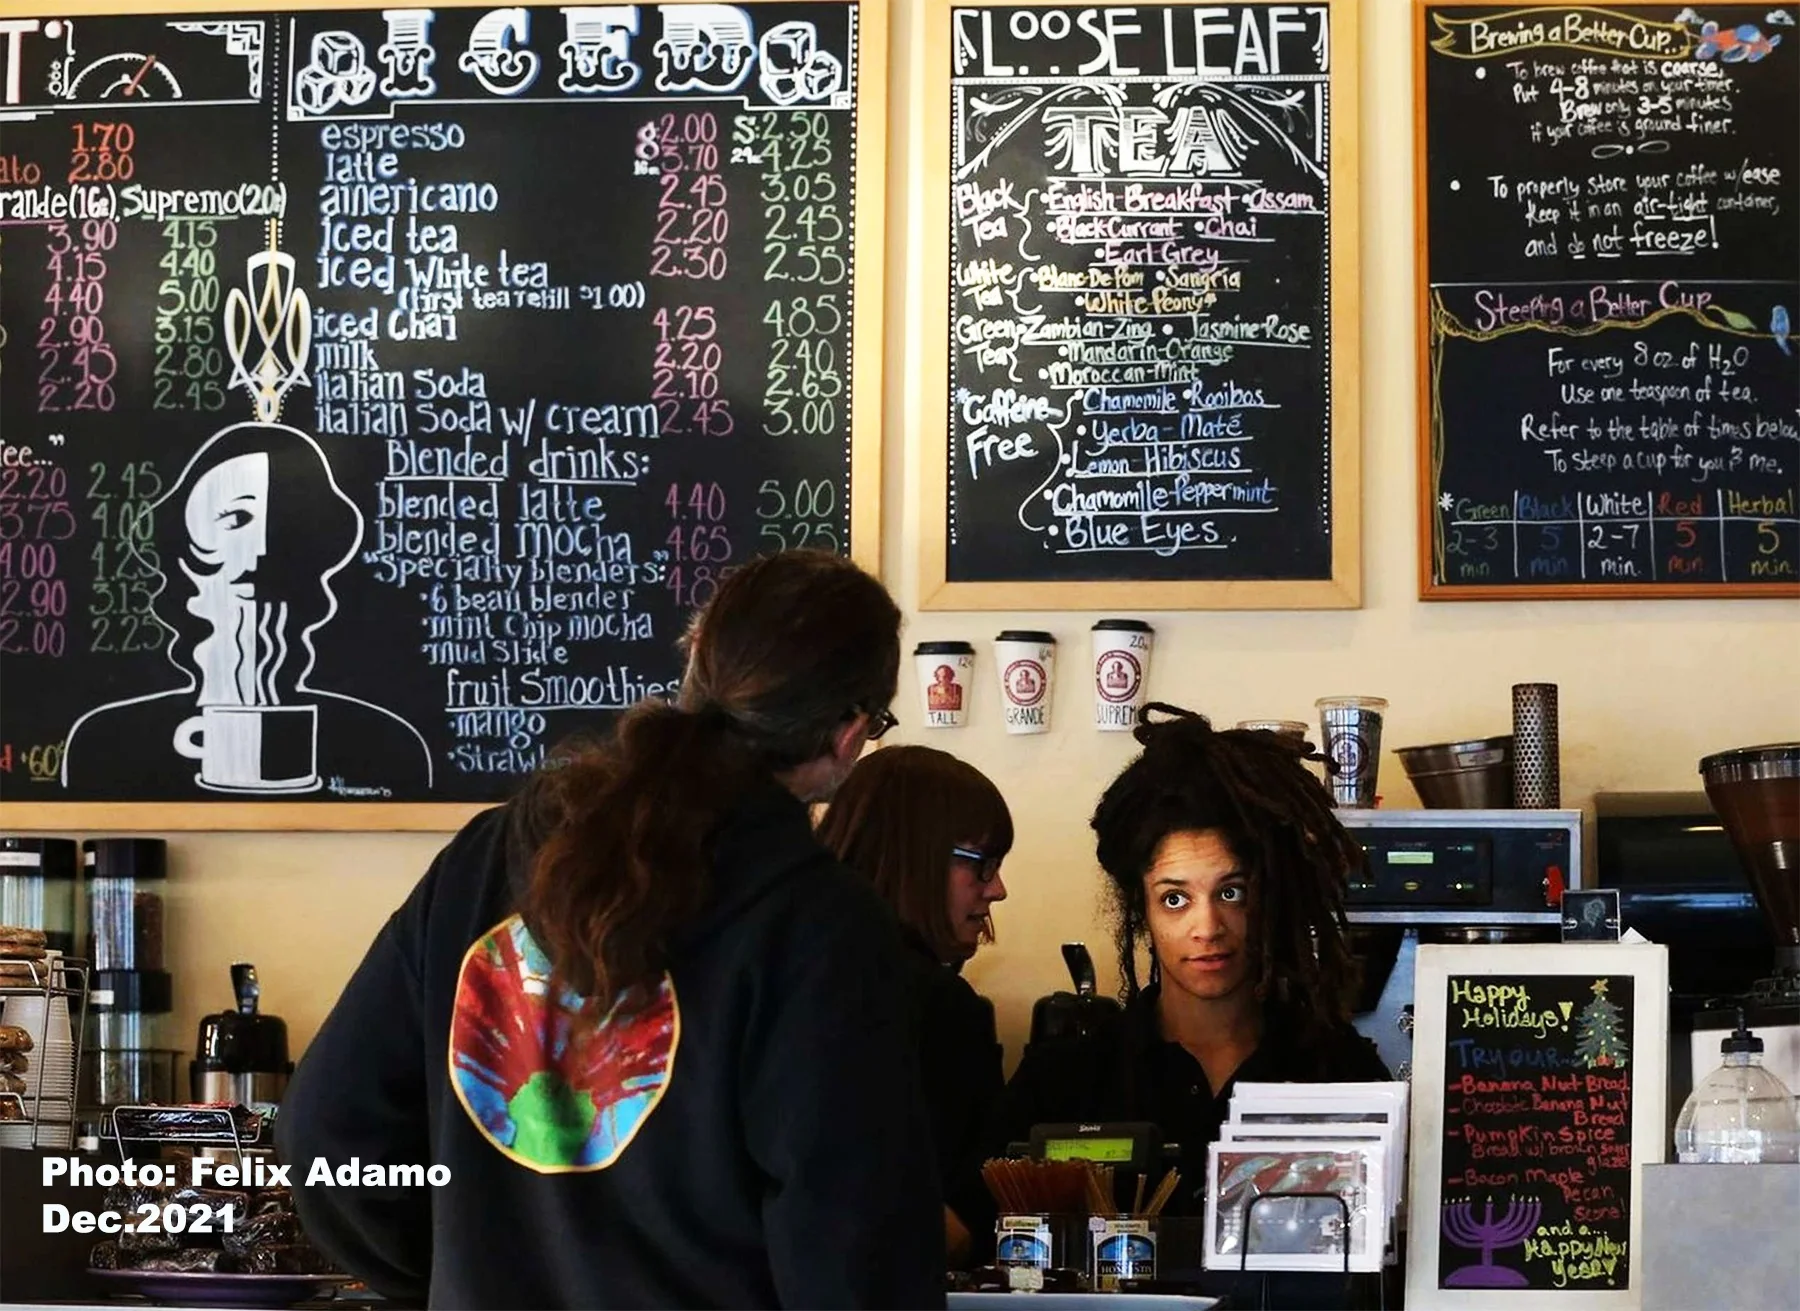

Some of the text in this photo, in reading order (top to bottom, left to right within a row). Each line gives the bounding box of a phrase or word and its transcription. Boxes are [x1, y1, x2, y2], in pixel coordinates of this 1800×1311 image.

[1163, 7, 1306, 76] LEAF
[1471, 13, 1627, 53] Brewing a Better
[378, 5, 756, 97] ICED
[1506, 58, 1723, 80] To brew coffee is coarse,
[1512, 75, 1694, 104] Put 4-8 minutes your
[1560, 94, 1732, 124] Brew only 3-5 minutes
[71, 123, 134, 153] 1.70
[321, 122, 465, 153] espresso
[1042, 105, 1250, 177] TEA
[1530, 112, 1736, 146] if your is ground finer.
[68, 152, 134, 184] 2.80
[325, 152, 398, 183] latte
[761, 138, 832, 172] 4.25
[320, 178, 498, 216] americano
[659, 174, 727, 209] 2.45
[957, 178, 1018, 218] Black
[1487, 162, 1718, 202] To properly your coffee
[47, 219, 117, 254] 3.90
[321, 216, 458, 256] iced tea
[654, 208, 729, 244] 2.20
[765, 204, 843, 242] 2.45
[962, 211, 1008, 247] Tea
[1205, 215, 1257, 237] Chai
[1525, 214, 1719, 257] and do not freeze!
[317, 249, 549, 294] iced tea
[650, 245, 727, 280] 2.30
[763, 242, 845, 285] 2.55
[957, 258, 1016, 286] White
[1166, 263, 1241, 295] Sangria
[45, 282, 103, 317] 4.40
[157, 276, 219, 315] 5.00
[472, 288, 509, 309] tea
[962, 284, 1003, 311] Tea
[1475, 280, 1712, 331] Steeping a Better Cup
[37, 316, 103, 348] 2.90
[313, 307, 457, 341] iced Chai
[653, 306, 716, 342] 4.25
[763, 295, 841, 338] 4.85
[957, 315, 1015, 345] Green
[38, 343, 116, 383] 2.45
[154, 345, 222, 378] 2.80
[315, 338, 379, 372] milk
[768, 339, 834, 374] 2.40
[964, 340, 1008, 373] Tea
[1548, 341, 1700, 378] For every 8 of
[154, 378, 225, 410] 2.45
[414, 367, 486, 399] Soda
[1083, 380, 1265, 412] Chamomile Rooibos
[1561, 374, 1712, 408] Use one teaspoon of
[416, 398, 660, 447] Soda w/ cream
[660, 399, 734, 436] 2.45
[763, 398, 835, 436] 3.00
[1521, 410, 1751, 442] Refer to the table of times
[385, 434, 650, 480] Blended drinks:
[967, 425, 1039, 480] Free
[1144, 444, 1241, 477] Hibiscus
[1544, 444, 1724, 482] To for you
[375, 481, 607, 522] blended latte
[665, 481, 725, 521] 4.40
[756, 479, 835, 519] 5.00
[1455, 488, 1794, 521] Green Black White Red Herbal
[374, 520, 500, 557] blended
[666, 525, 732, 562] 4.65
[1141, 514, 1219, 556] Eyes
[1541, 520, 1781, 555] 5 2-7 5 5
[430, 584, 635, 612] 6 bean blender
[430, 614, 494, 639] mint
[447, 667, 515, 707] fruit
[456, 709, 546, 749] mango
[928, 711, 957, 725] TALL
[1006, 705, 1044, 725] GRANDE
[1452, 980, 1531, 1011] Happy
[1462, 1001, 1573, 1039] Holidays!
[1462, 1074, 1582, 1095] Banana Nut
[1532, 1093, 1628, 1112] Banana Nut
[1574, 1110, 1625, 1126] Bread
[1559, 1126, 1615, 1143] Spice
[1466, 1168, 1518, 1186] Bacon
[1537, 1219, 1573, 1236] and
[1524, 1237, 1593, 1262] Happy
